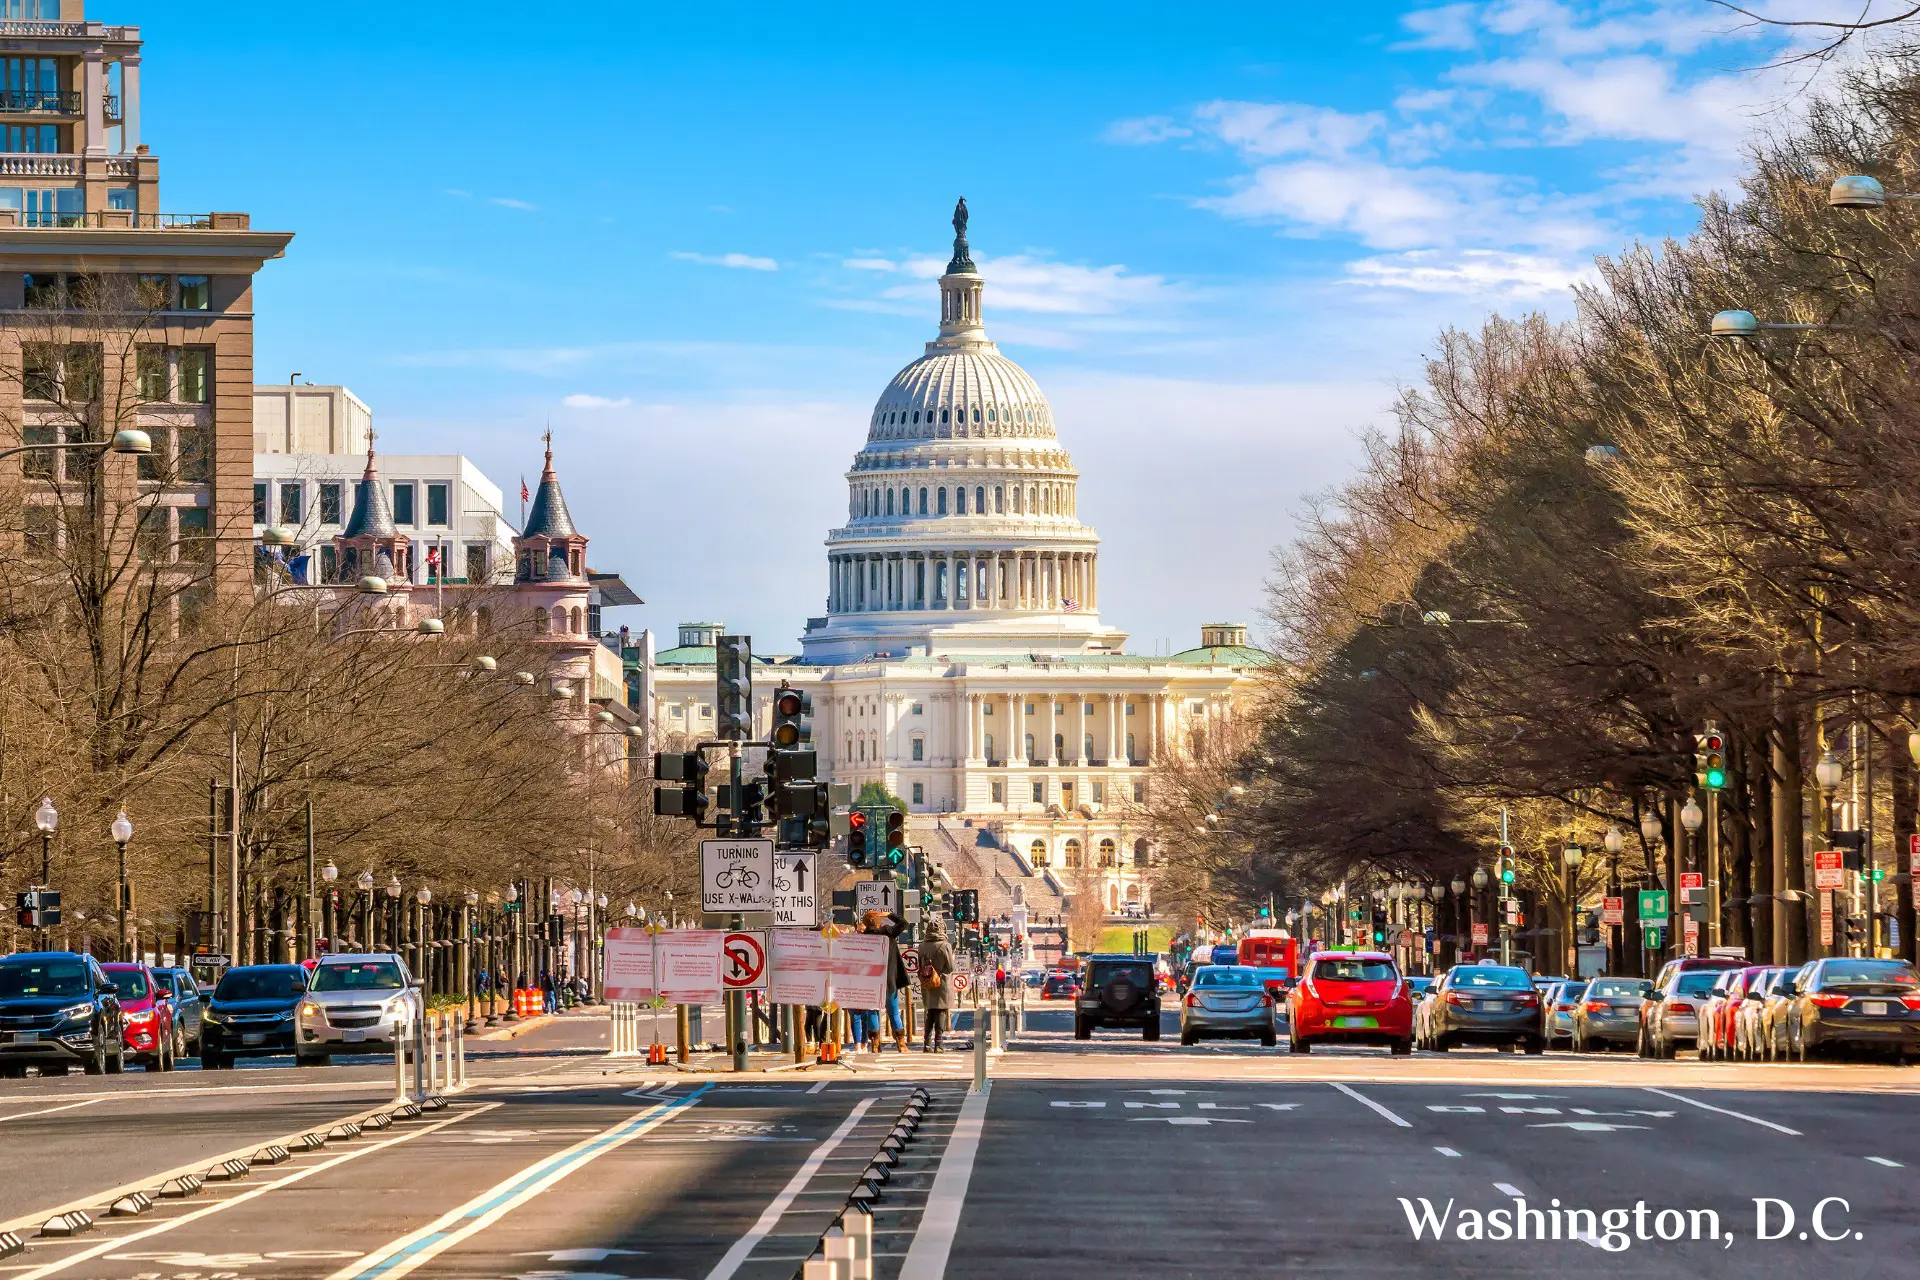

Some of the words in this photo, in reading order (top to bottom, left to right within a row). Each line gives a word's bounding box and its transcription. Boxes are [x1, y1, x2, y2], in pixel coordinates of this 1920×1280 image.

[717, 848, 759, 859] TURNING
[775, 858, 787, 870] RU
[859, 884, 877, 892] THRU
[705, 893, 724, 904] USE
[775, 896, 786, 908] EY
[791, 896, 813, 908] THIS
[776, 910, 796, 922] NAL
[1050, 1101, 1304, 1110] ONLY
[1425, 1105, 1678, 1118] ONLY
